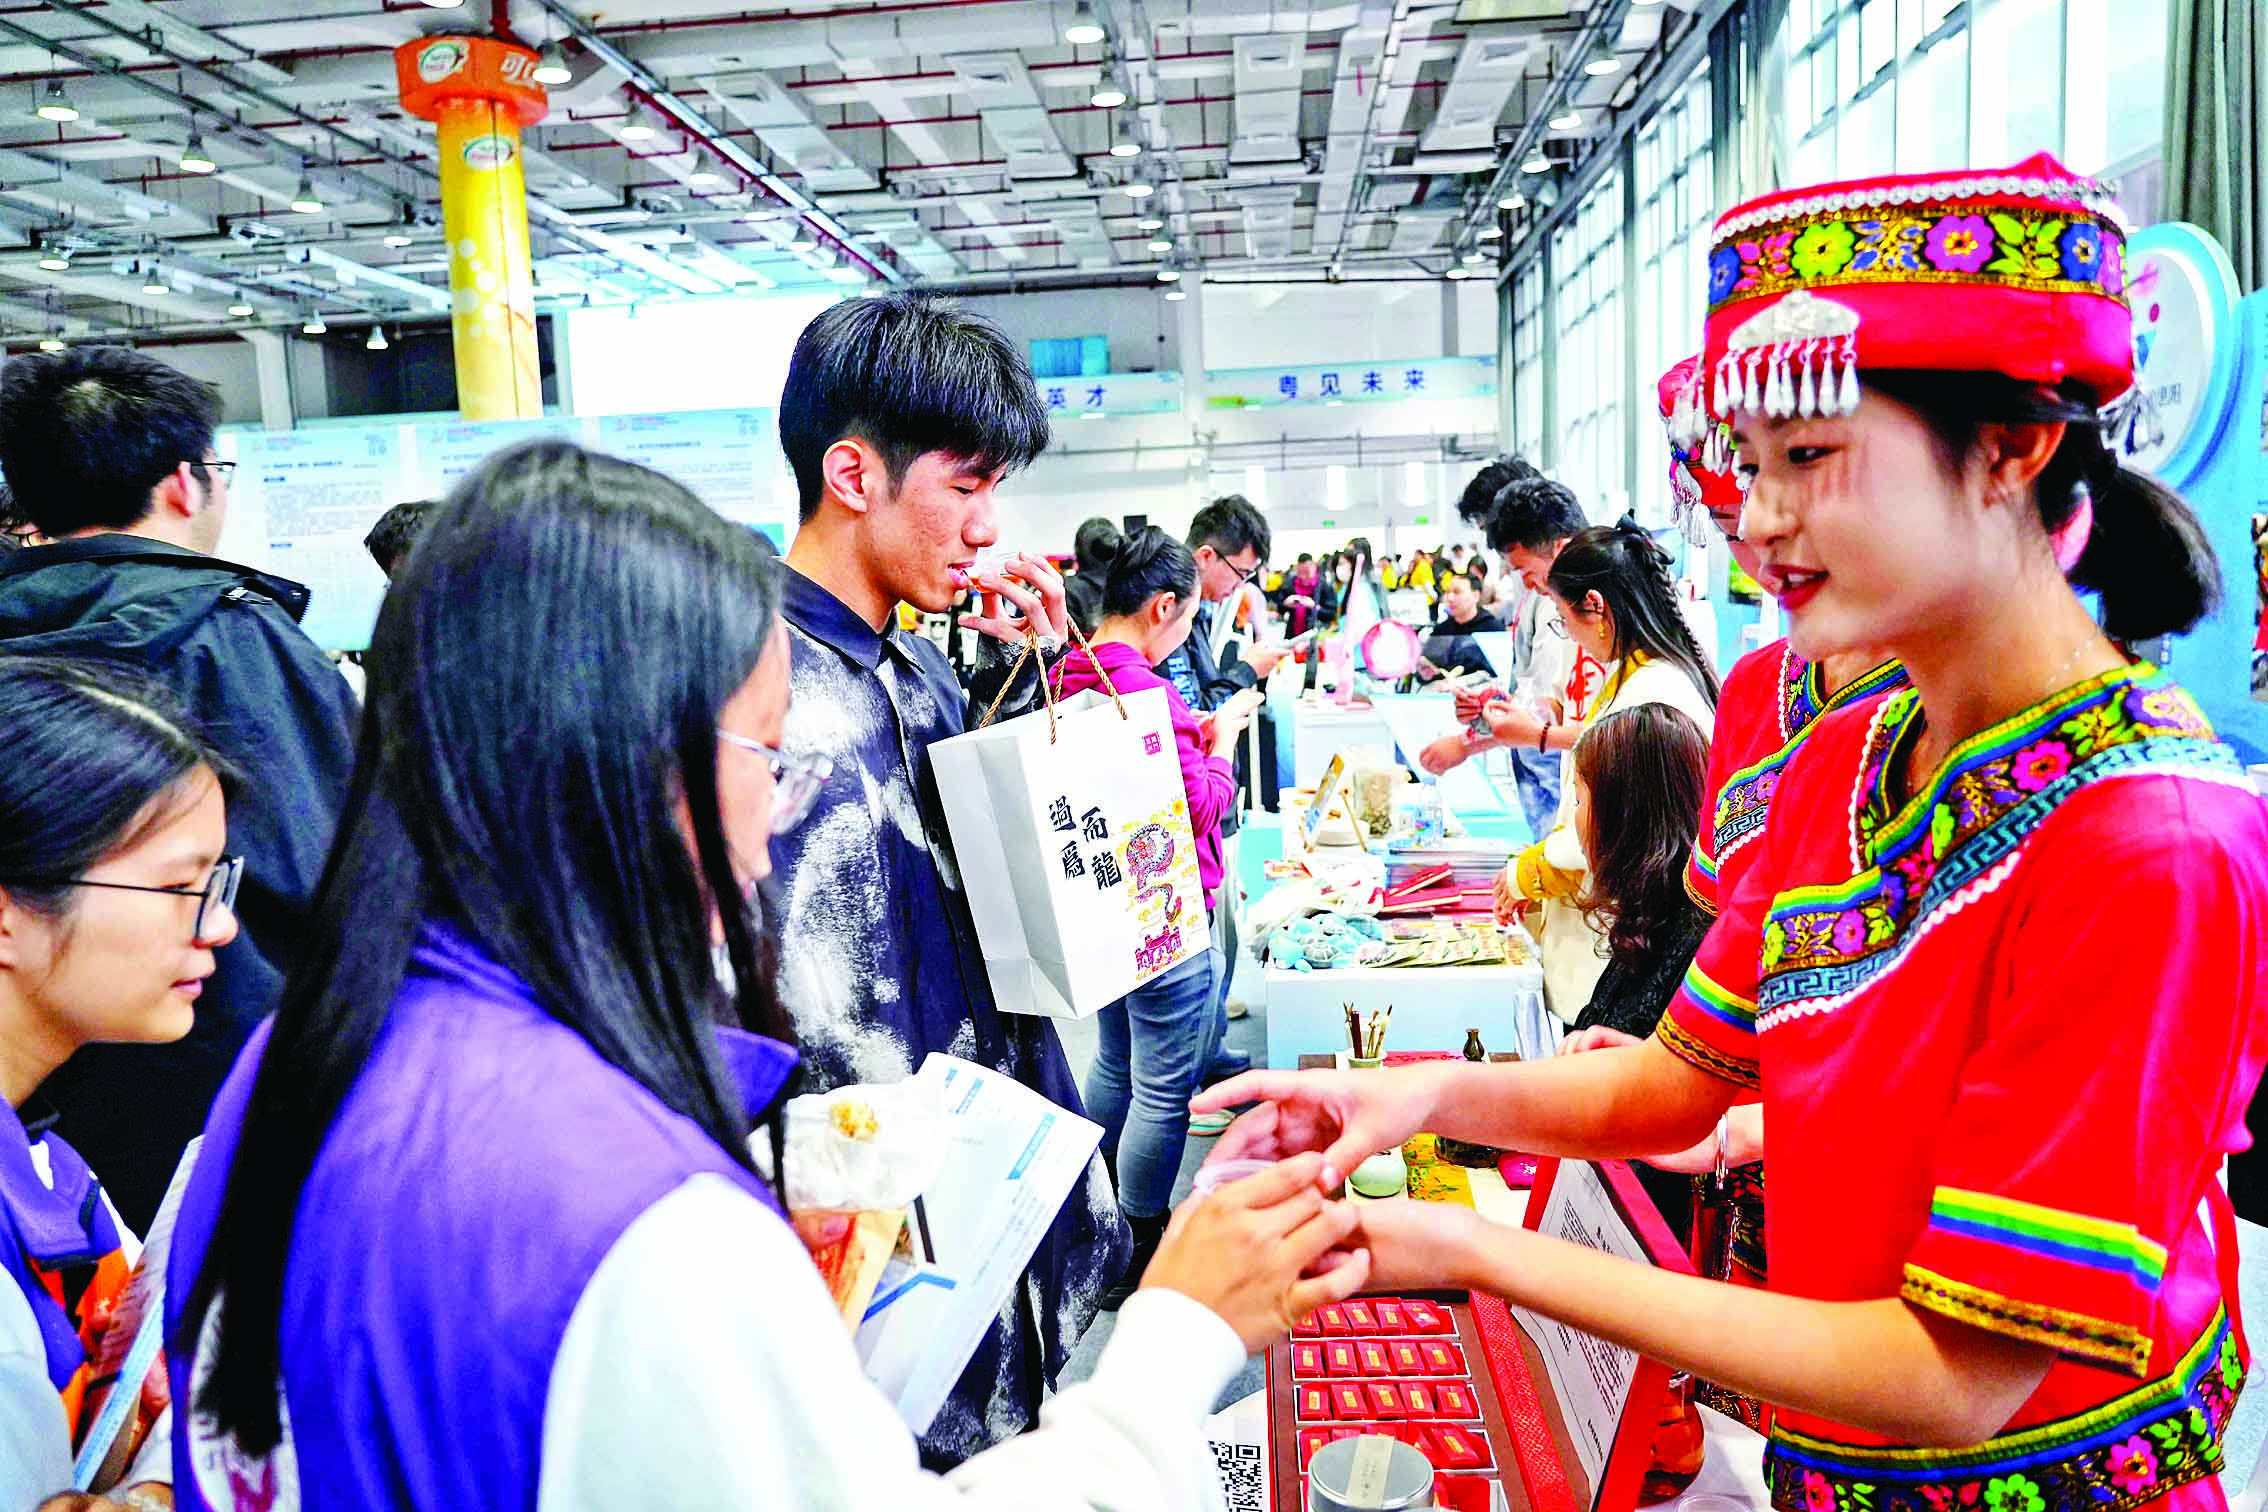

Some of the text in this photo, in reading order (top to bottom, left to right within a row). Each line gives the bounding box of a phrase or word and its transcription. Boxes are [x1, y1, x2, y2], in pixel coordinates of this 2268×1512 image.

[1047, 384, 1107, 410] 英才
[1279, 368, 1425, 399] 粤见未来
